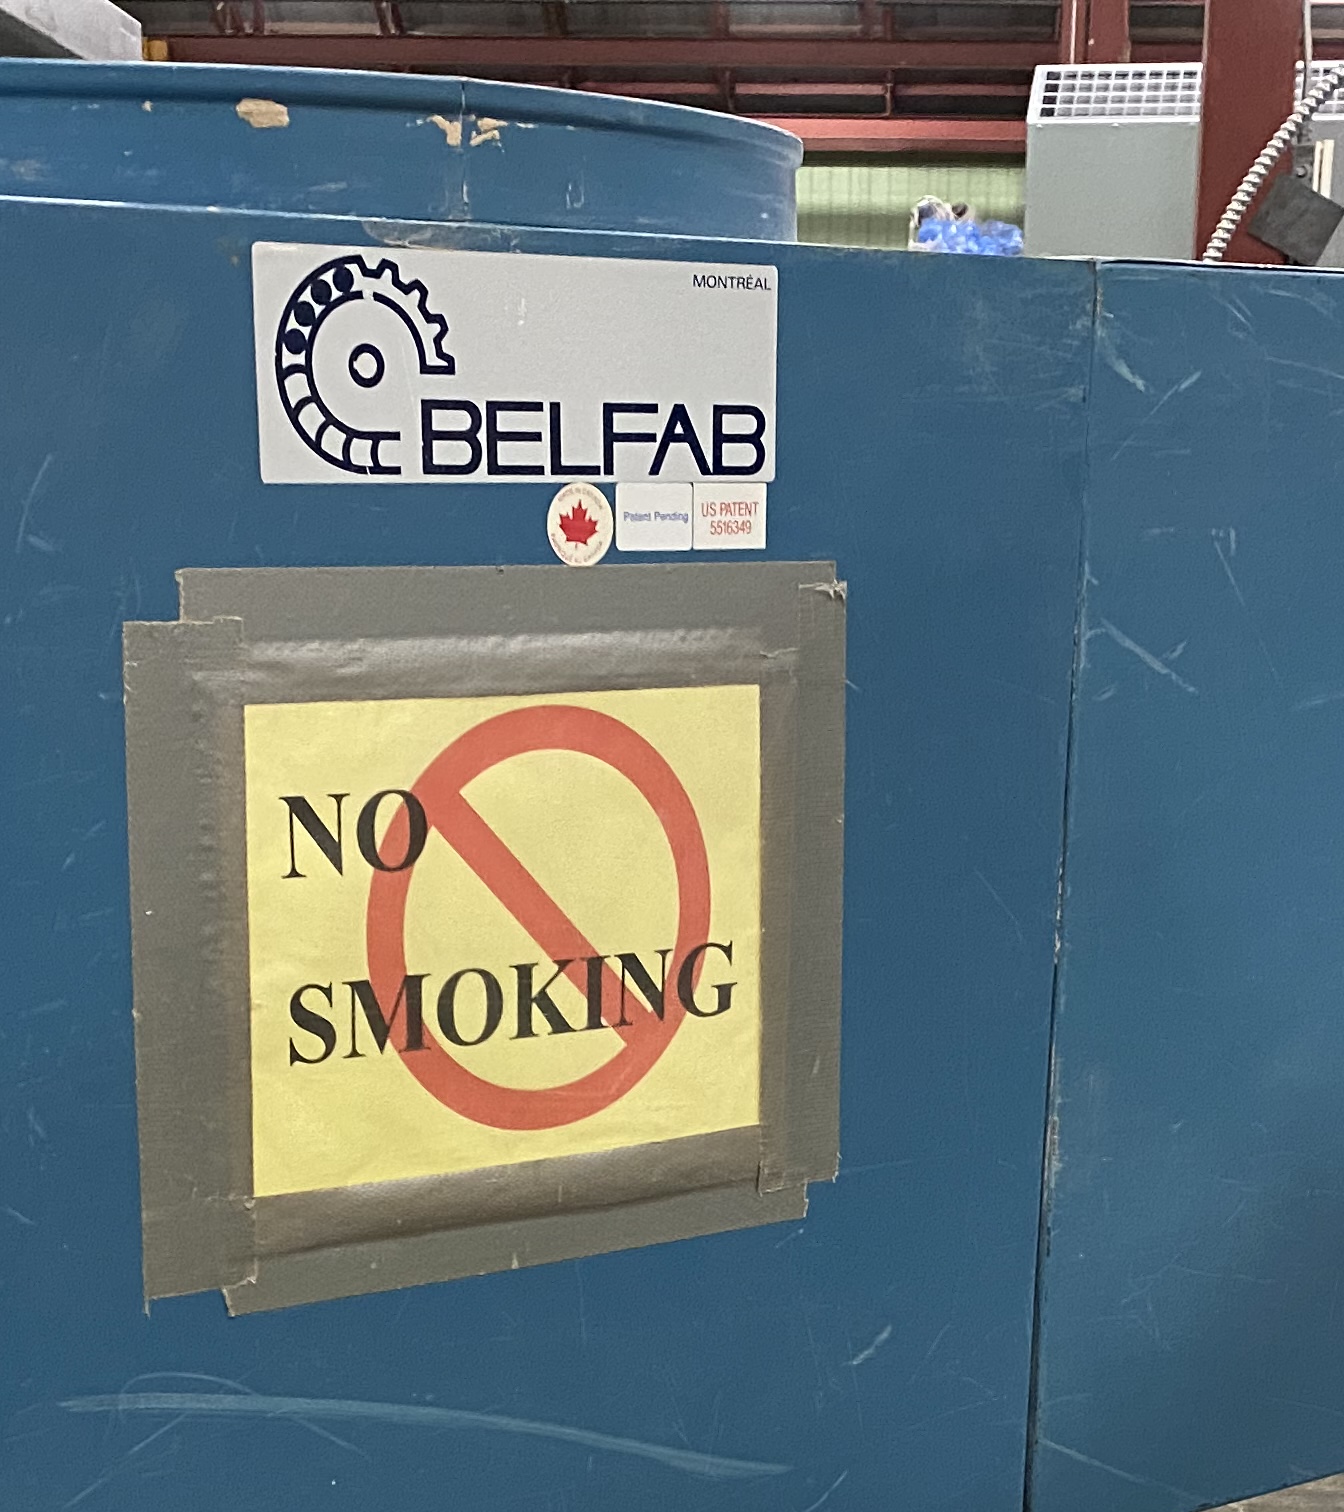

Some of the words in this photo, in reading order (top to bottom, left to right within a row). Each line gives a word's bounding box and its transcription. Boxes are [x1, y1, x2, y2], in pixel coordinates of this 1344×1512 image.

[692, 274, 772, 291] MONTRÉAL
[421, 400, 767, 476] BELFAB
[654, 511, 689, 524] Pending
[701, 502, 717, 518] US
[719, 501, 759, 518] PATENT
[709, 519, 752, 536] 5516349
[278, 788, 429, 880] NO
[288, 940, 738, 1067] SMOKING
